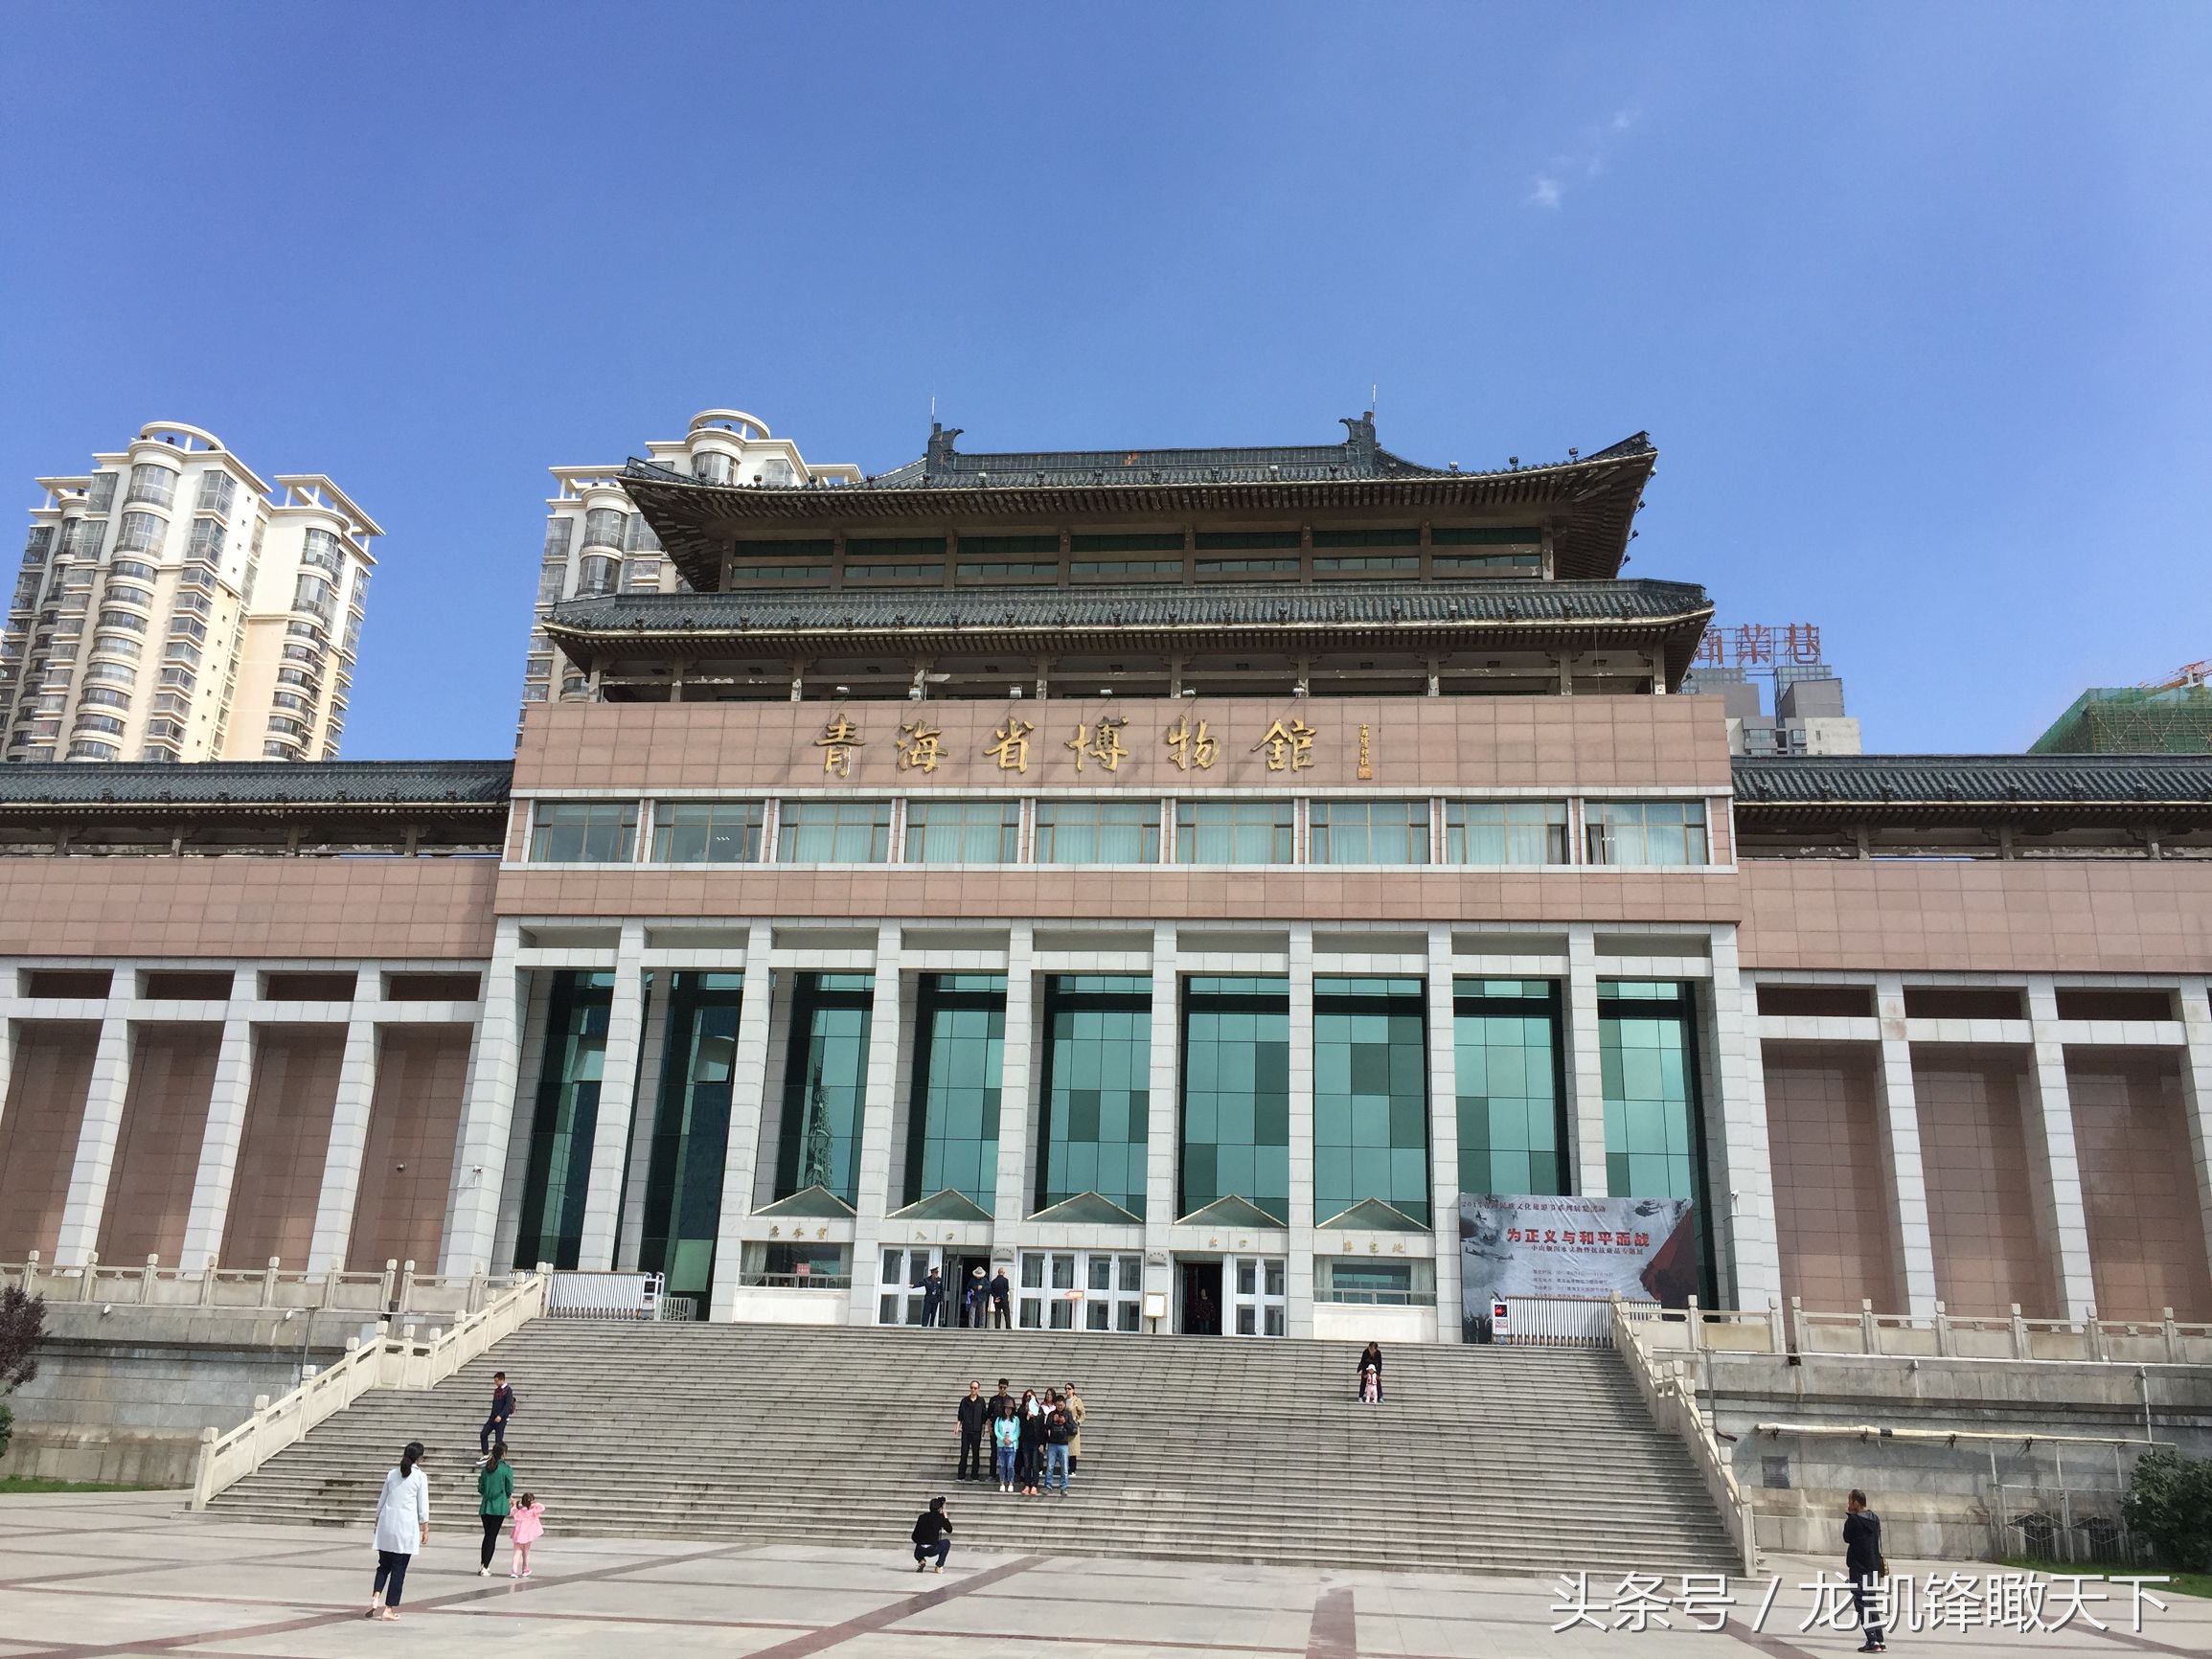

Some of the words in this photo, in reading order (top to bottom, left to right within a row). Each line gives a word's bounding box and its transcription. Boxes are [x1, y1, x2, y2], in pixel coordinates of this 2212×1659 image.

[1507, 1228, 1650, 1248] 为正义与和平而战
